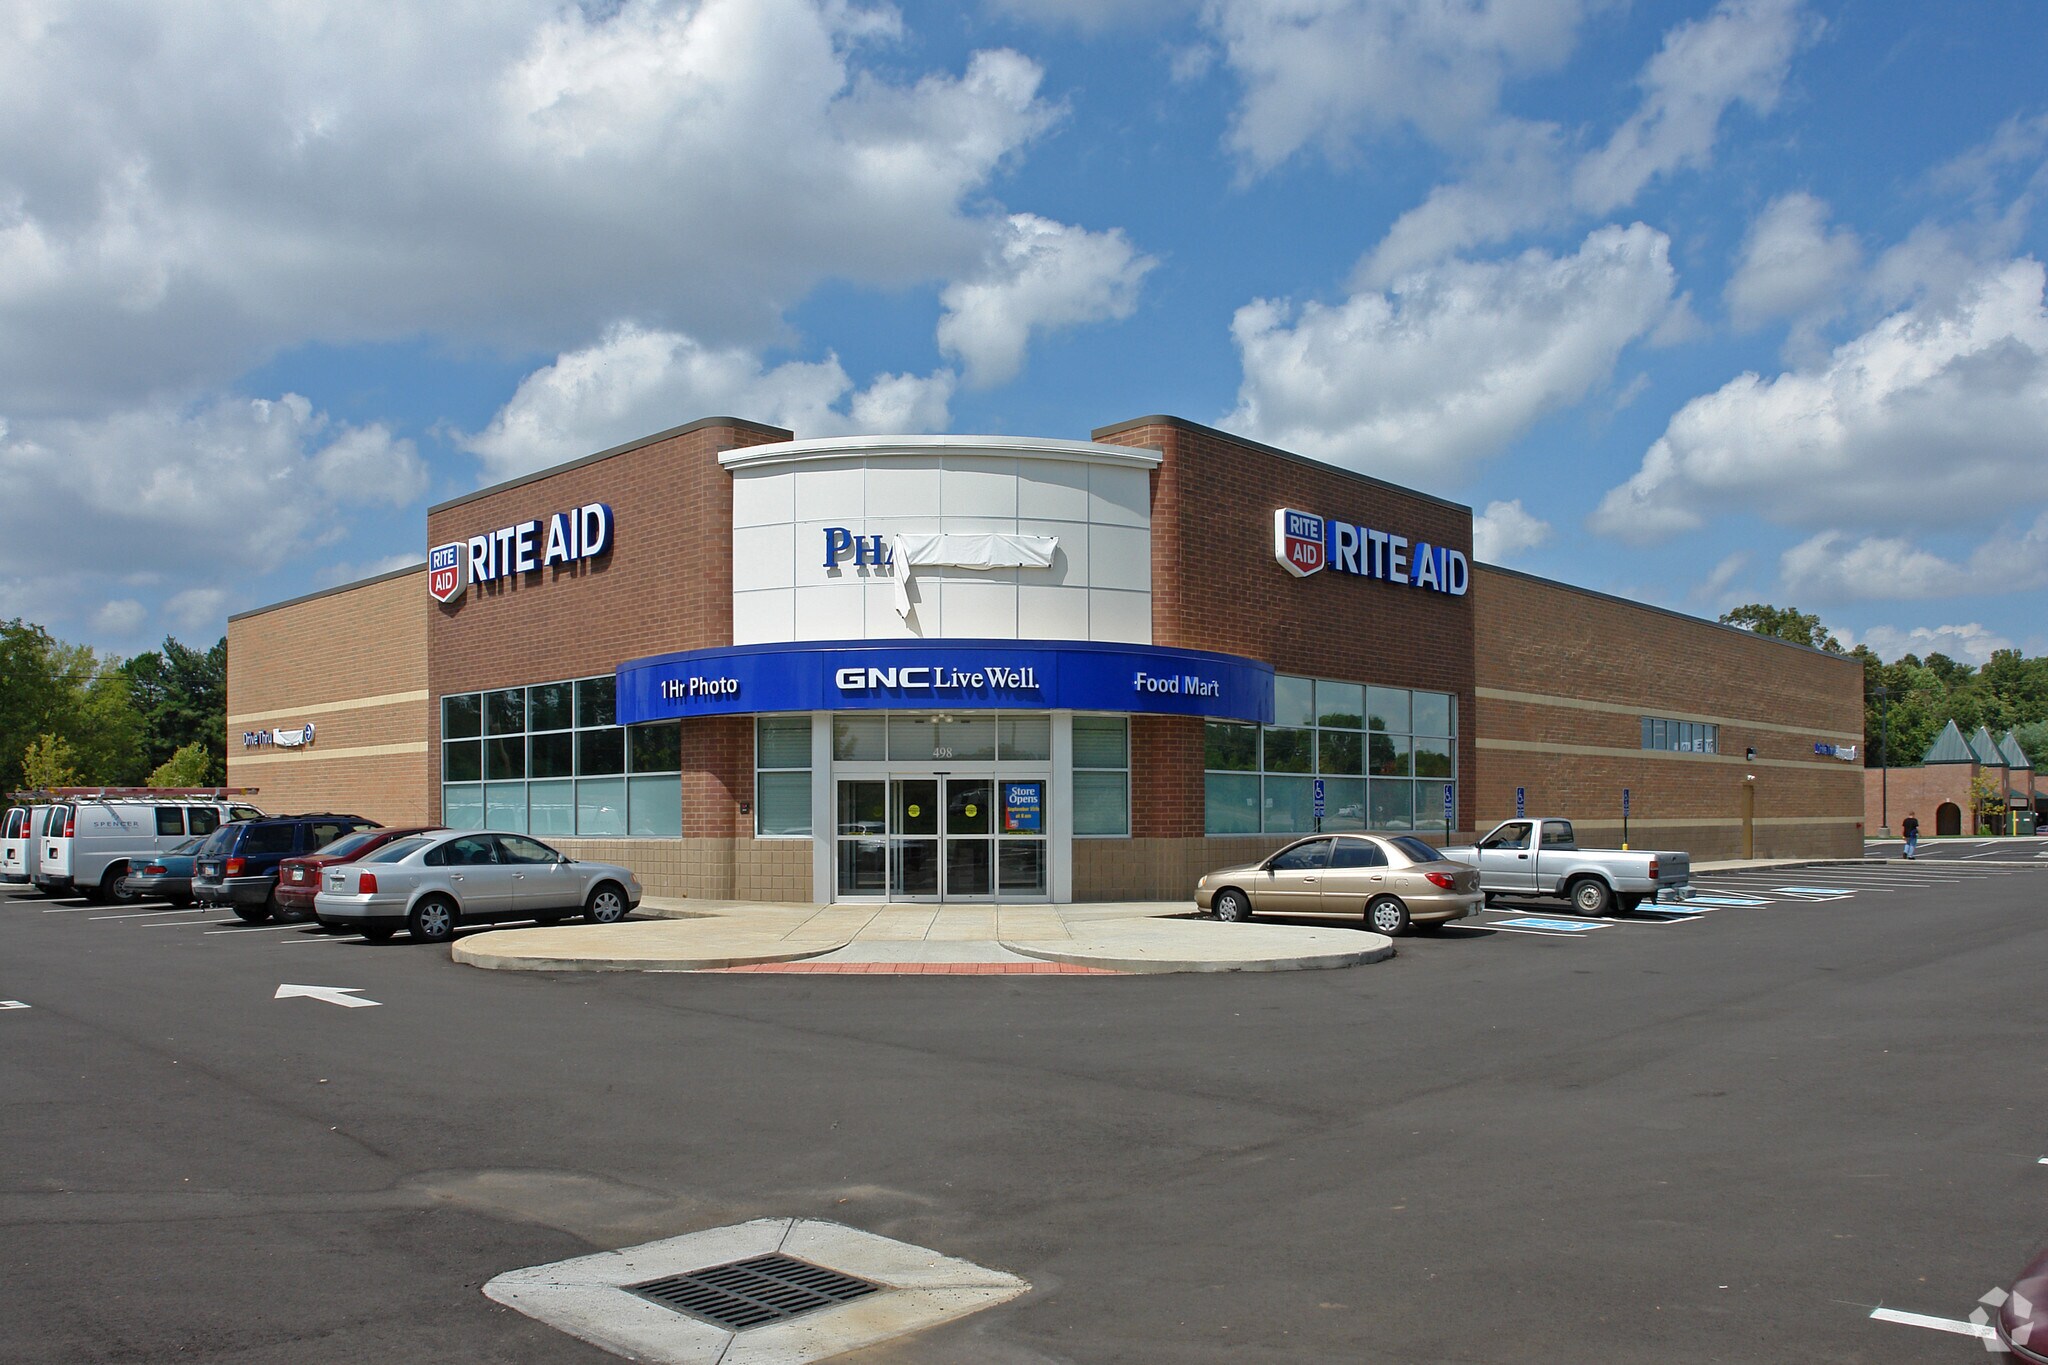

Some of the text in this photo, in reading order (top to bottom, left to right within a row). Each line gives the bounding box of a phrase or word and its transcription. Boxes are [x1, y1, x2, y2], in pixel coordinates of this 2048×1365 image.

[1290, 515, 1319, 539] RITE
[468, 502, 610, 584] RITE AID
[1292, 542, 1318, 565] AID
[433, 547, 455, 569] RITE
[1333, 520, 1470, 596] RITE AID
[435, 571, 453, 592] AID
[689, 676, 739, 697] Photo
[835, 667, 1040, 689] GNC Live Well.
[1136, 671, 1220, 697] Food Mart
[932, 747, 953, 759] 498
[1009, 794, 1039, 805] Opens
[1011, 786, 1036, 796] Store
